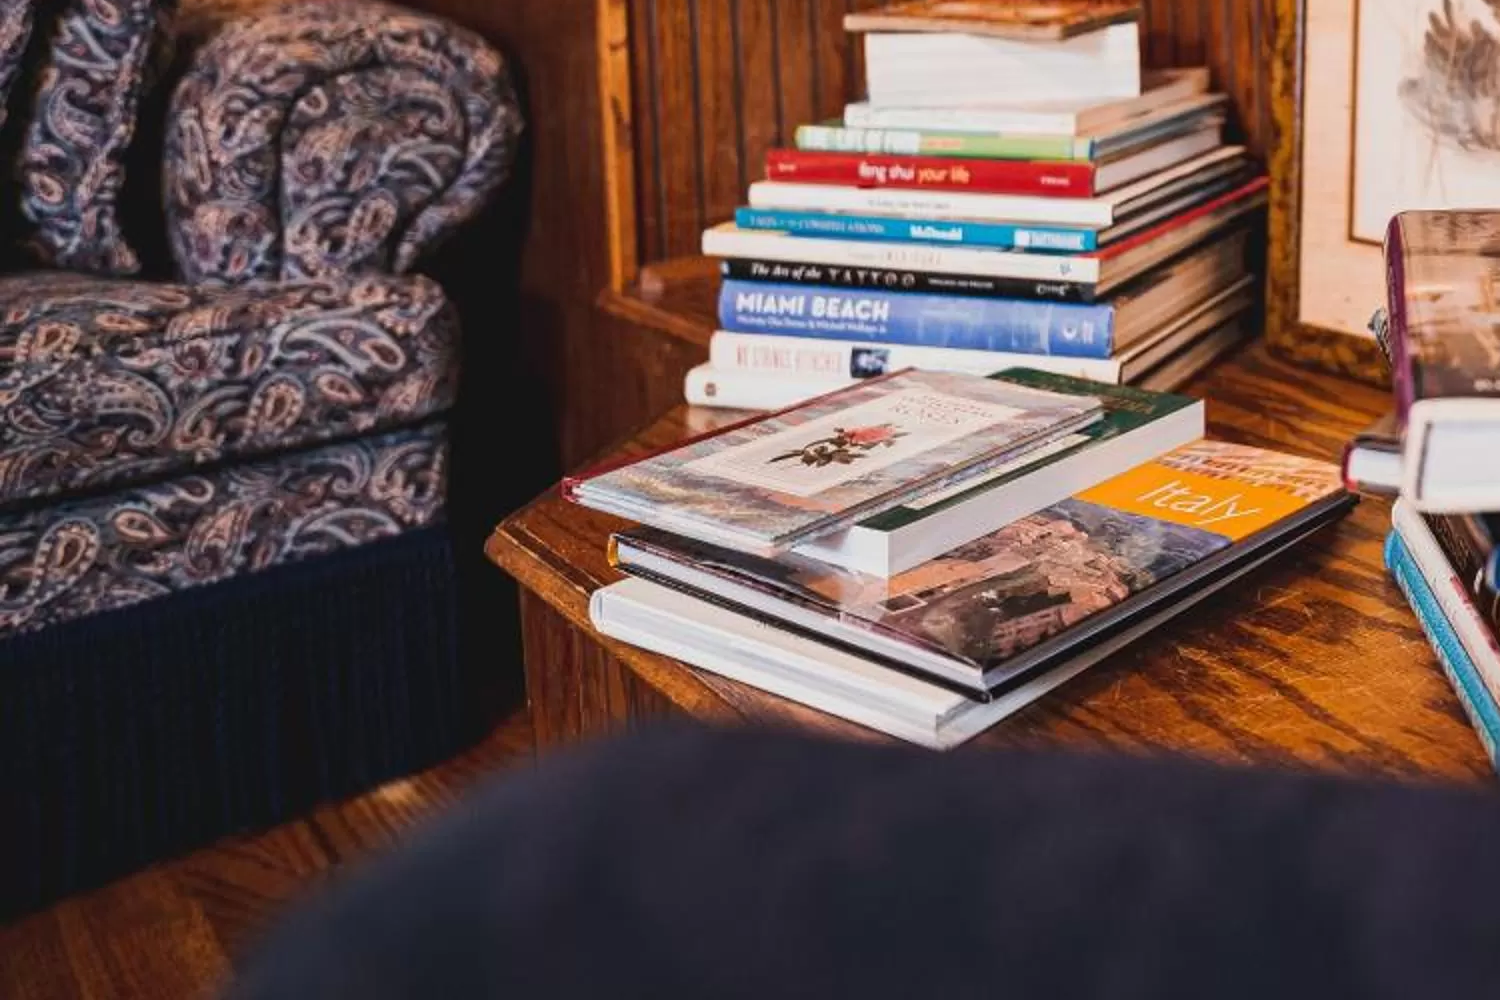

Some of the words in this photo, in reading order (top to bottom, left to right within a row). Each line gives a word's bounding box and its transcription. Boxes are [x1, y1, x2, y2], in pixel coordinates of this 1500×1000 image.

[917, 166, 946, 184] your
[751, 261, 770, 277] The
[773, 263, 790, 279] Art
[736, 291, 806, 317] MIAMI
[811, 296, 889, 322] BEACH
[1136, 479, 1264, 526] Italy
